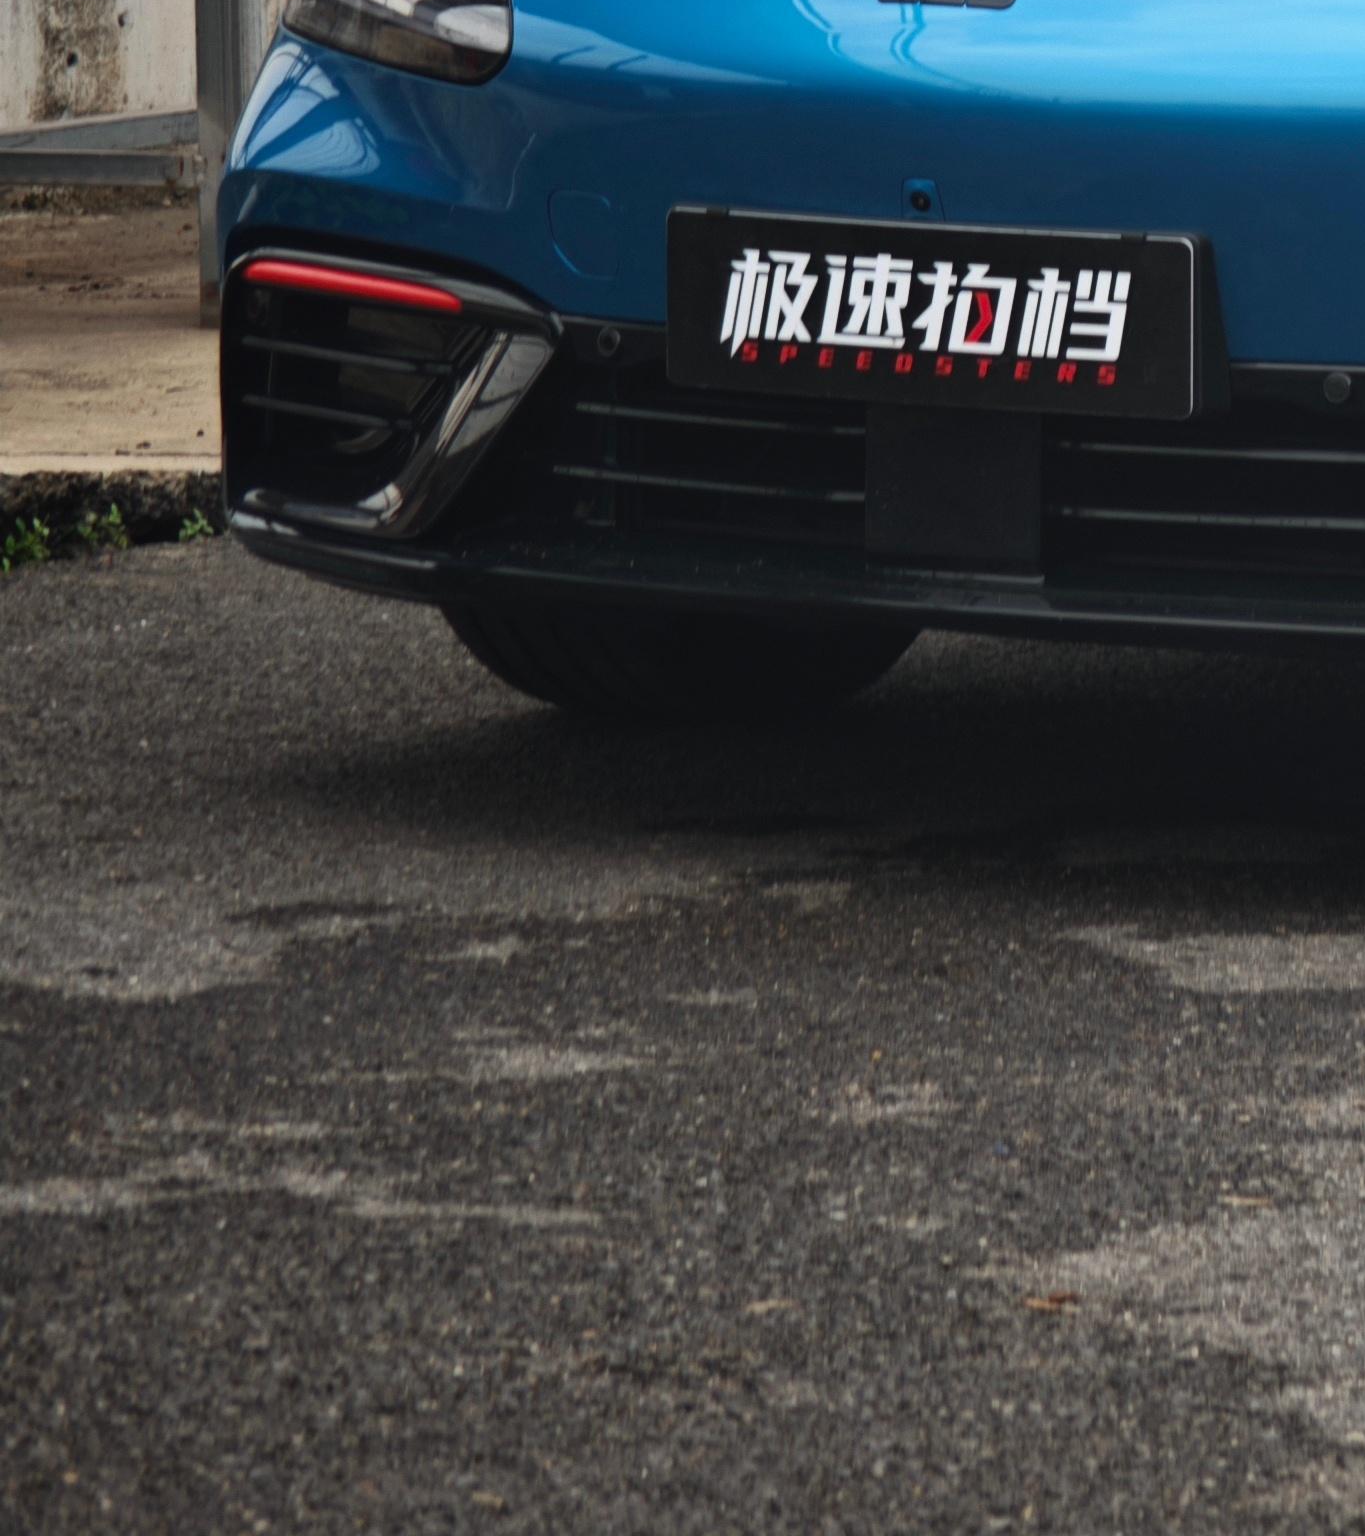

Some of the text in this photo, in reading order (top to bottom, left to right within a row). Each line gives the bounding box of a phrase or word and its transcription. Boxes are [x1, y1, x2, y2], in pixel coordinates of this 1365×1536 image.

[720, 248, 1132, 362] 极速拍档
[741, 341, 1118, 385] SPEEDSTERS
